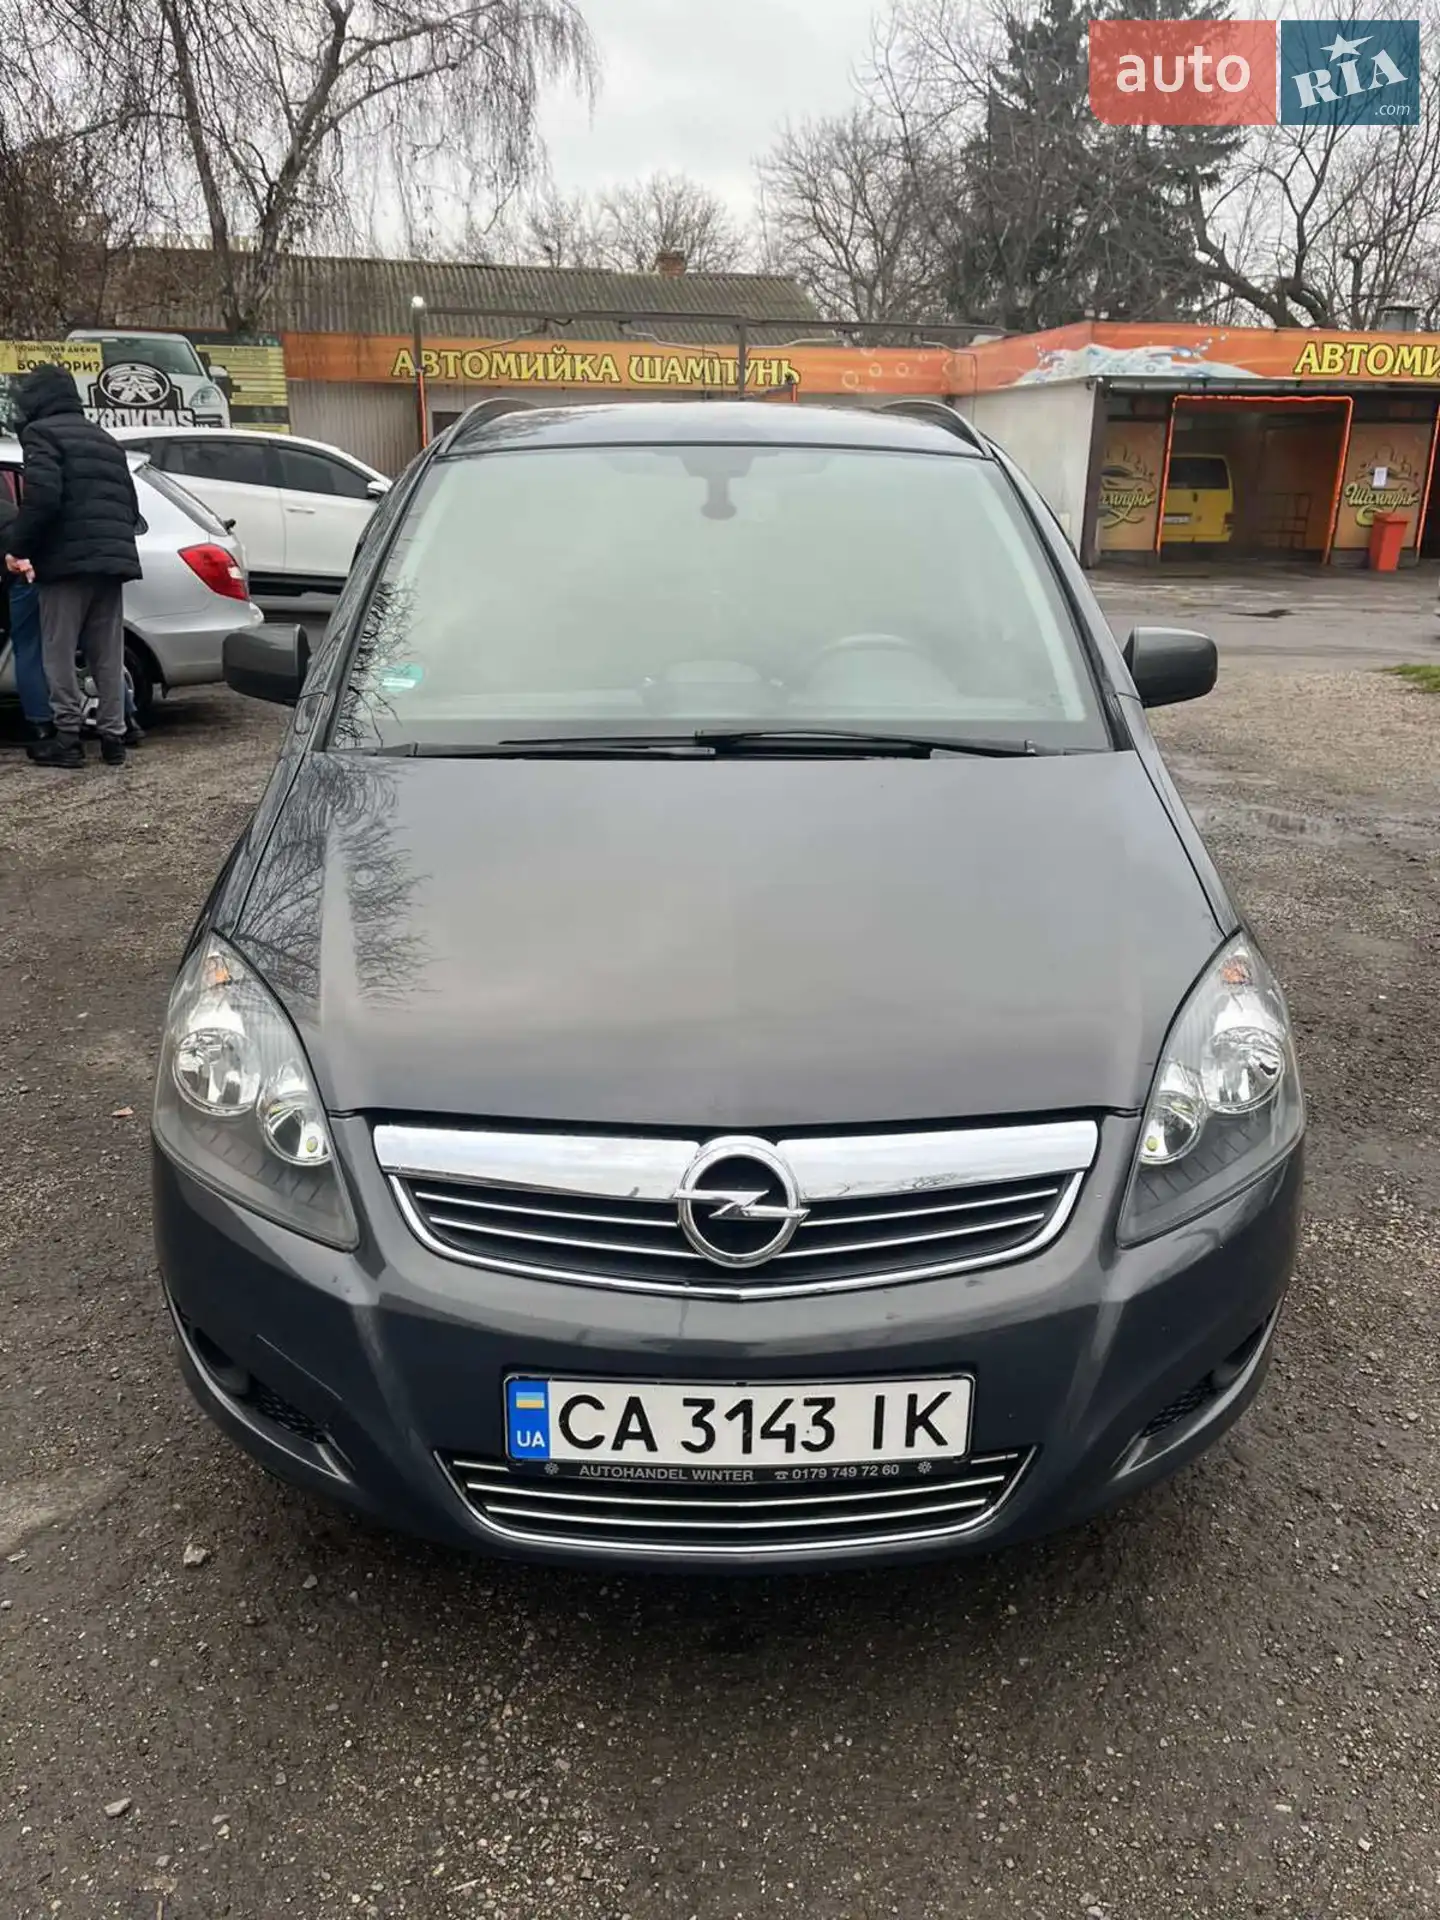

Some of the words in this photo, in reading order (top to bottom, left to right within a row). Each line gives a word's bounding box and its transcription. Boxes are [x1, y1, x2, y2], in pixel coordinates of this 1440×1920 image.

[392, 345, 621, 383] АВТОМИЙКА
[628, 355, 800, 386] ШАМПУНЬ
[559, 1394, 658, 1452] CA
[680, 1396, 836, 1454] 3143
[873, 1391, 952, 1450] IK
[516, 1430, 545, 1448] UA
[579, 1464, 688, 1480] AUTOHANDEL
[691, 1467, 754, 1482] WINTER
[791, 1466, 828, 1480] 0179
[831, 1465, 857, 1479] 749
[861, 1464, 878, 1477] 72
[882, 1463, 900, 1476] 60
